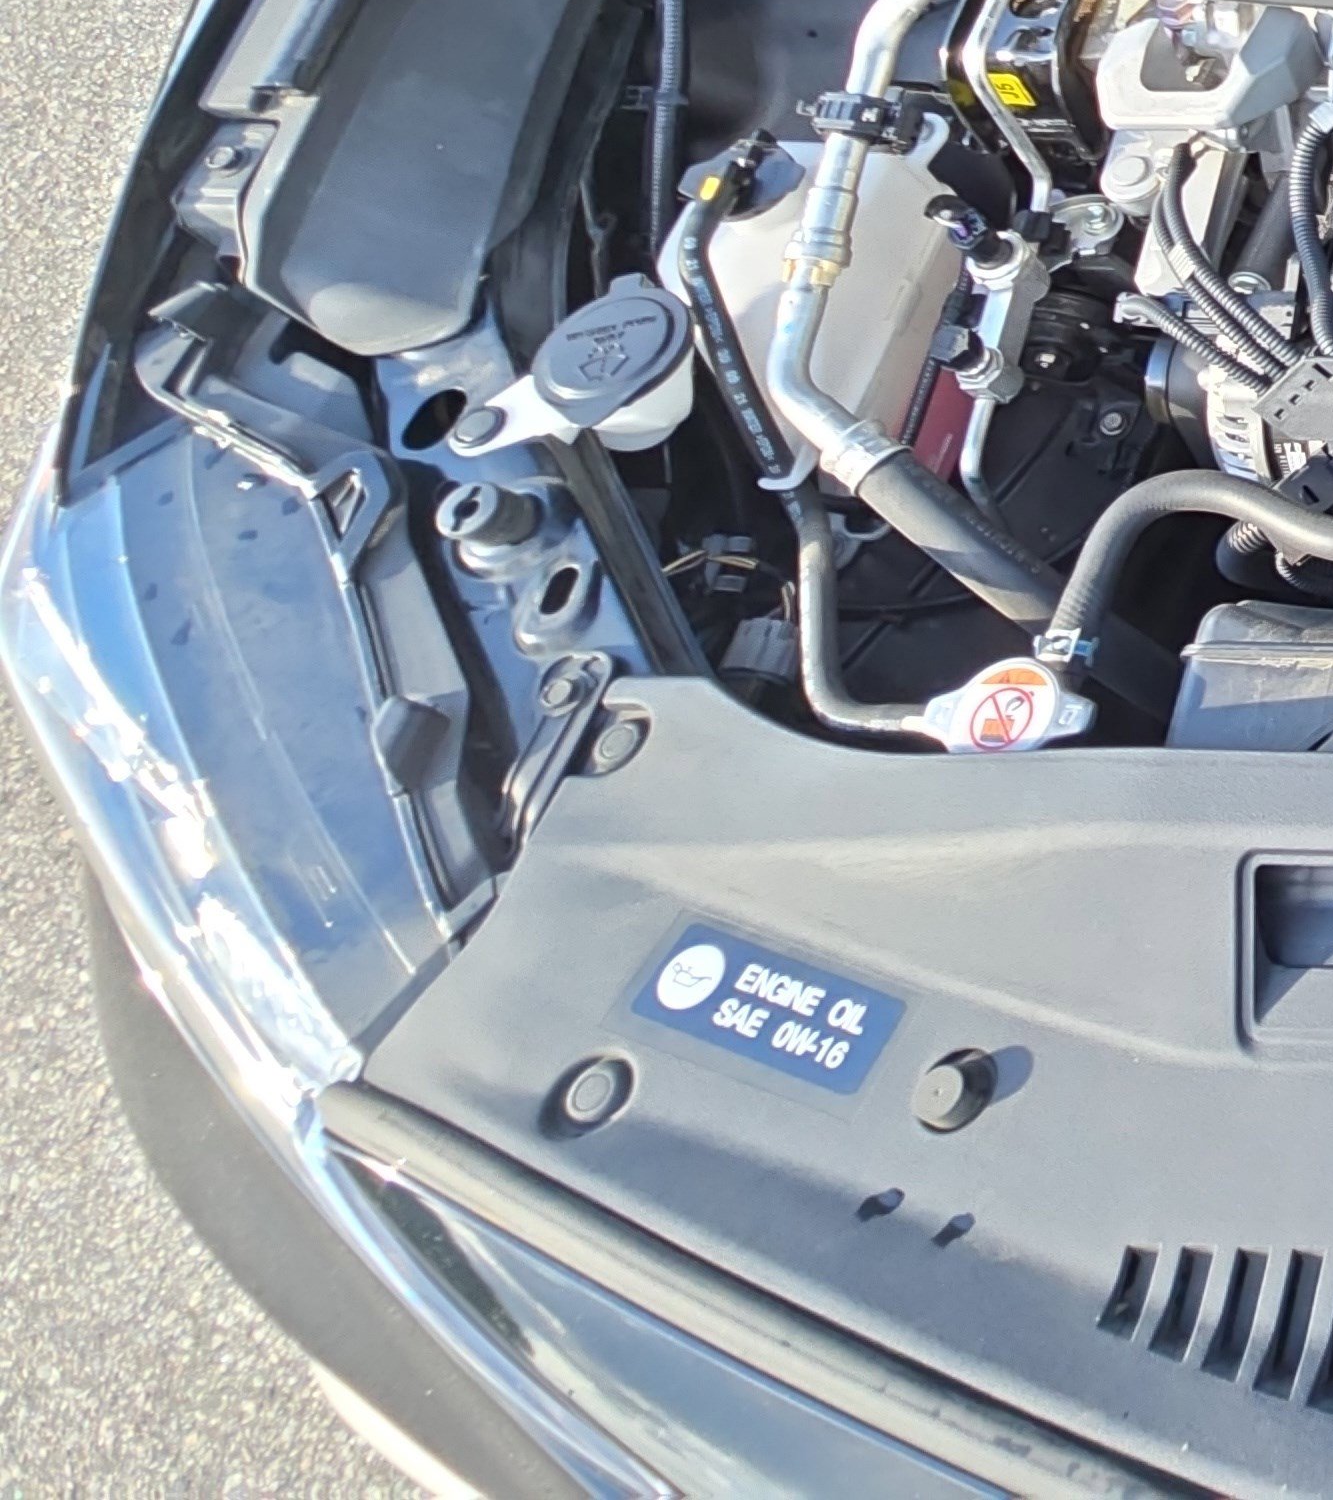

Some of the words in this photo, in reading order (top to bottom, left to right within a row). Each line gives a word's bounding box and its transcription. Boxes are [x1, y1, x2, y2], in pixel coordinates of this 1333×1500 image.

[713, 997, 770, 1038] SAE
[771, 1020, 850, 1070] 0W-16
[734, 963, 827, 1016] ENGINE
[827, 998, 868, 1036] OIL
